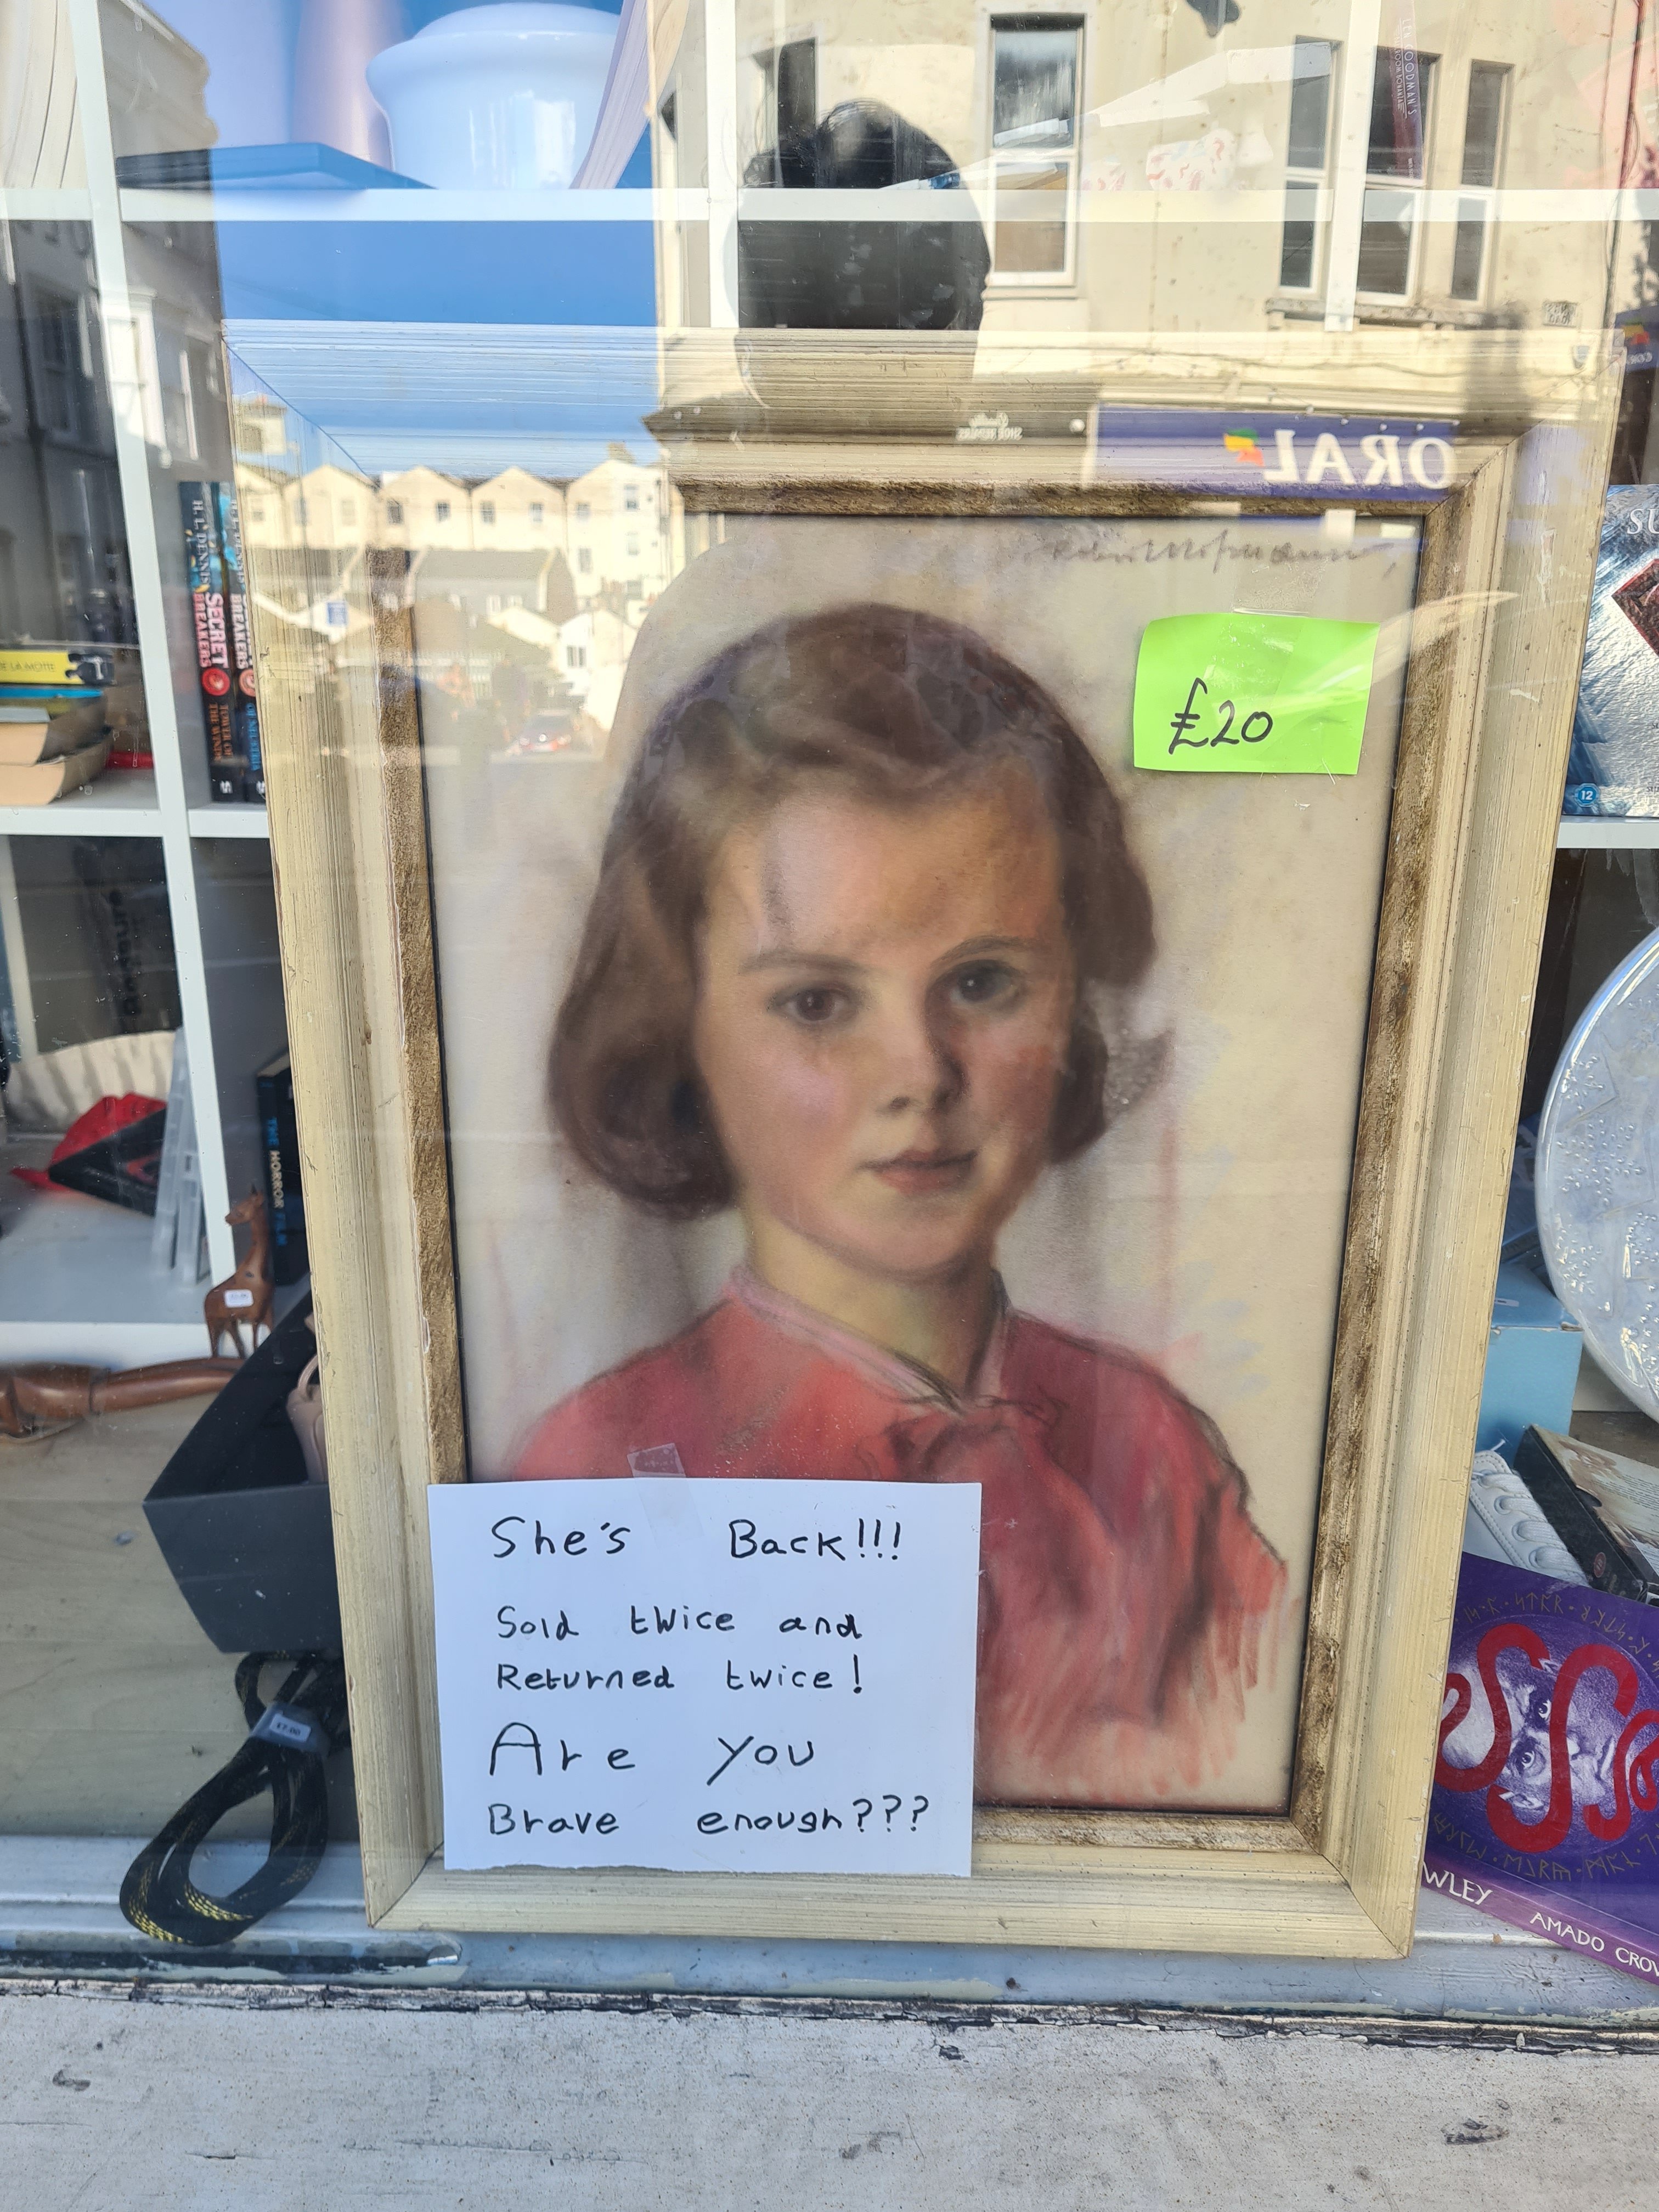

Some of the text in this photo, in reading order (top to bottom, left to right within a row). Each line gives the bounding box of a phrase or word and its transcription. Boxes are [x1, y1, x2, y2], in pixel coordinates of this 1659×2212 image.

[1404, 44, 1418, 115] GOODMAN'S
[196, 532, 211, 584] DENNIS
[193, 592, 212, 668] BREAKERS
[205, 591, 229, 669] SECRET
[230, 592, 249, 670] BREAKERS
[1167, 676, 1275, 755] £20
[1580, 789, 1594, 800] 12
[267, 1116, 280, 1147] THE
[269, 1150, 285, 1209] HORROR
[491, 1515, 902, 1562] She's Back!!!
[496, 1605, 580, 1640] Sold
[779, 1615, 864, 1640] and
[496, 1662, 676, 1691] Returned
[489, 1722, 636, 1777] Are
[489, 1795, 931, 1836] Brave enough???
[1423, 1860, 1493, 1906] WLEY
[1530, 1911, 1605, 1953] AMADO
